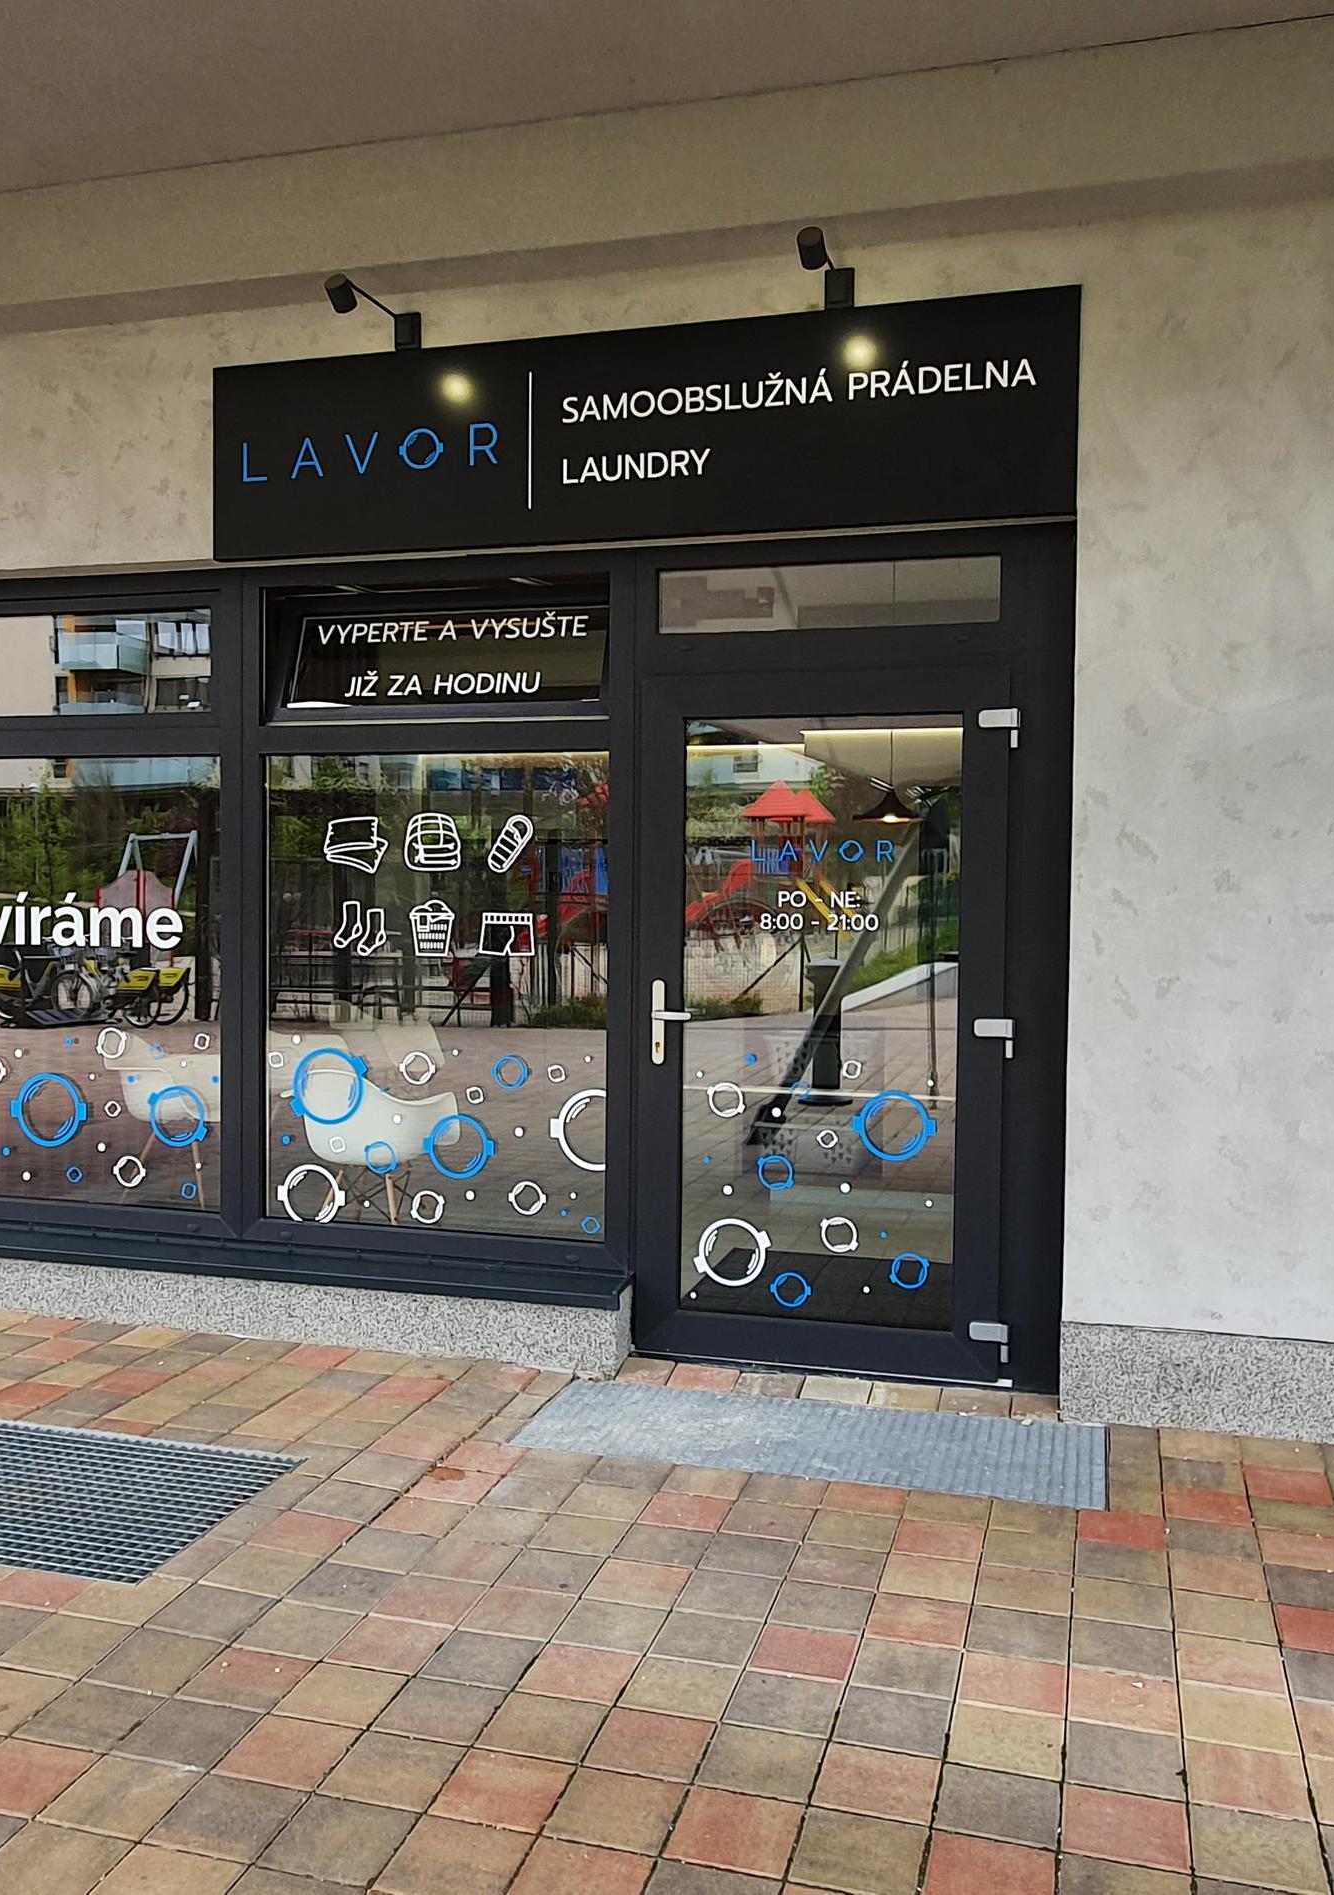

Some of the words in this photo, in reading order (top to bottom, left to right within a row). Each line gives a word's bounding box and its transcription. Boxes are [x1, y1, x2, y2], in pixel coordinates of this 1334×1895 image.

[561, 367, 834, 424] SAMOOBSLUŽNÁ
[847, 358, 1037, 401] PRÁDELNA
[242, 422, 499, 483] LAVOR
[562, 448, 711, 485] LAUNDRY
[318, 620, 430, 645] VYPERTE
[438, 620, 457, 641] A
[470, 611, 589, 640] VYSUŠTE
[344, 670, 379, 697] JIŽ
[387, 674, 423, 696] ZA
[433, 671, 542, 695] HODINU
[749, 839, 896, 864] LAVOR
[777, 890, 807, 909] PO
[830, 891, 861, 909] NE:
[759, 912, 804, 931] 8:00
[826, 913, 880, 932] 21:00
